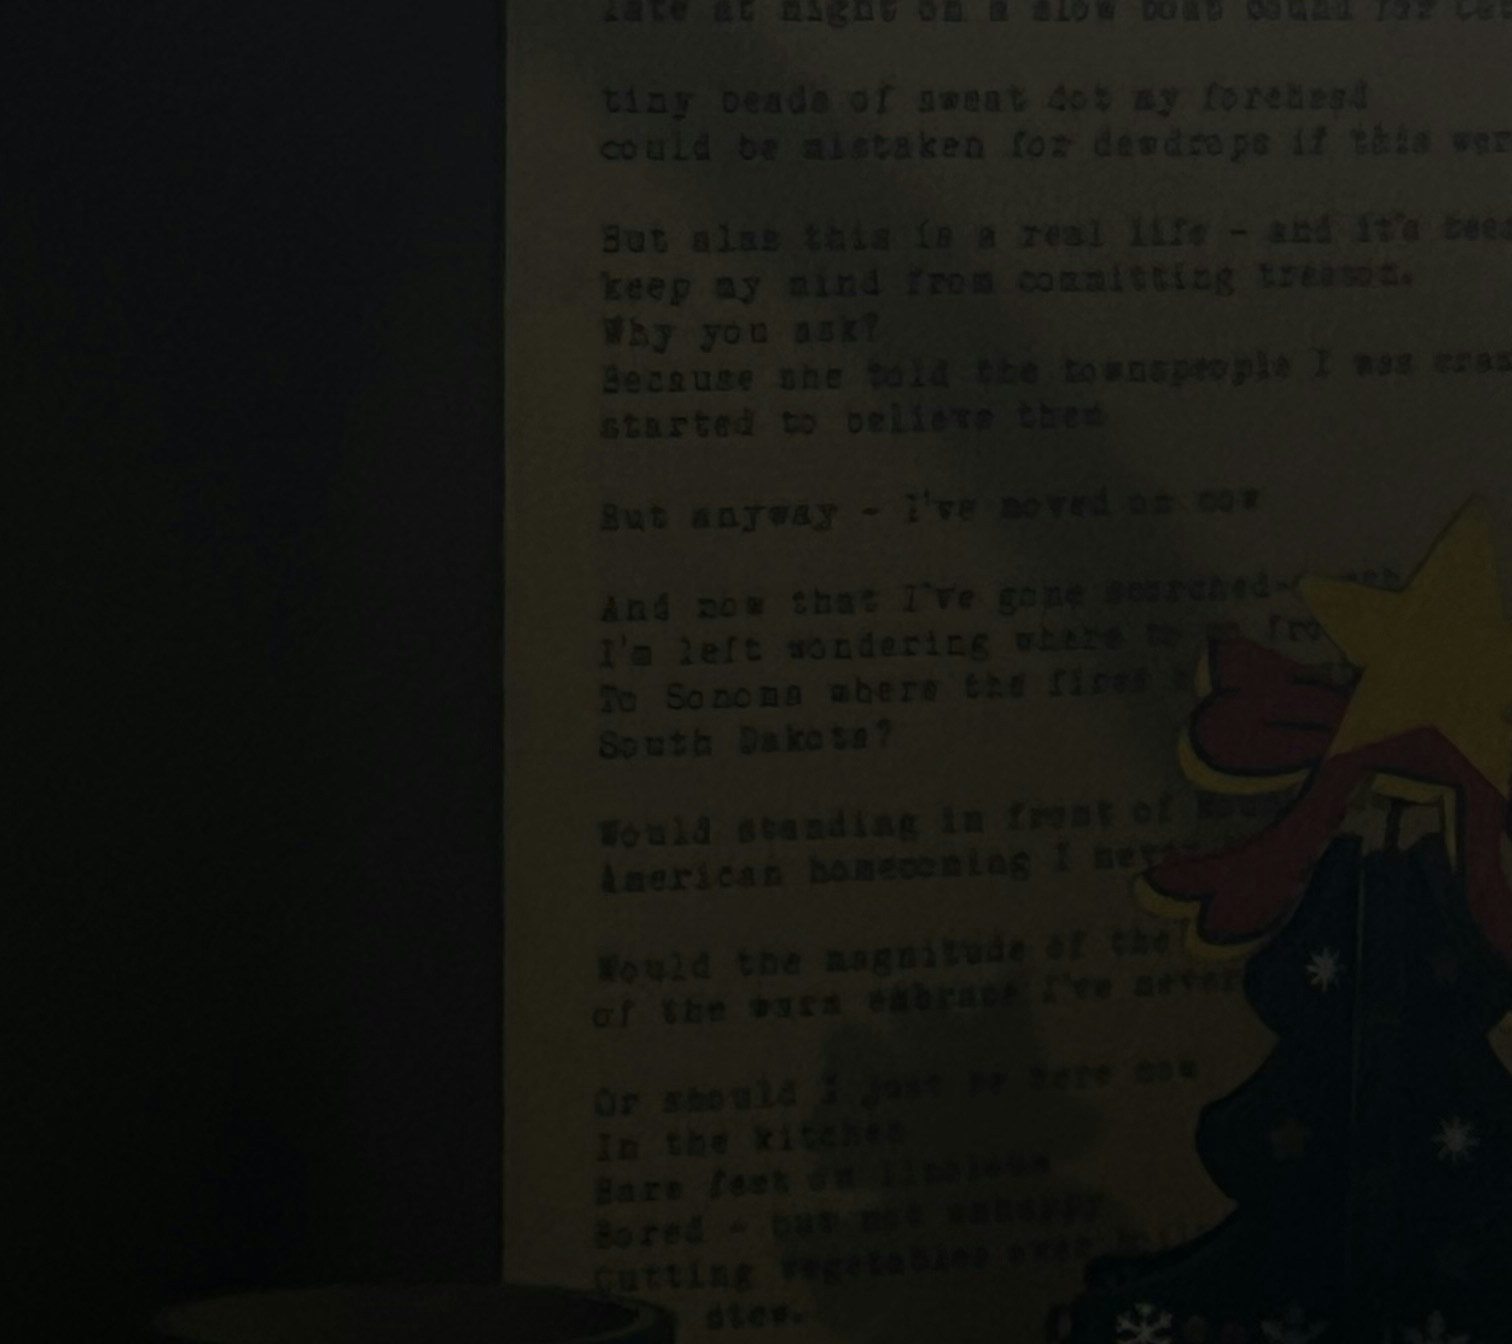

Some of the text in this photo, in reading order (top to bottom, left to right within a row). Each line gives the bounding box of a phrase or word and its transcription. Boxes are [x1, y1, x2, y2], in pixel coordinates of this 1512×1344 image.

[601, 86, 695, 121] tiny
[849, 84, 896, 115] of
[1047, 84, 1113, 112] dot
[1133, 87, 1180, 118] my
[600, 130, 712, 161] could
[738, 132, 779, 161] be
[801, 128, 986, 161] mistaken
[1011, 128, 1072, 159] for
[1092, 126, 1271, 162] dewdrops
[1291, 125, 1328, 157] if
[601, 224, 669, 254] But
[692, 223, 782, 253] alas
[804, 222, 890, 252] this
[917, 219, 954, 250] is
[977, 223, 997, 248] a
[1021, 220, 1105, 247] real
[1130, 216, 1208, 247] life
[1267, 214, 1333, 244] and
[601, 271, 691, 306] keep
[714, 272, 762, 304] my
[789, 268, 882, 298] mind
[906, 268, 995, 296] from
[1015, 264, 1237, 296] committing
[601, 311, 881, 353] Why you ask?
[601, 363, 755, 395] Because
[867, 357, 951, 389] told
[976, 356, 1040, 386] the
[1064, 349, 1292, 386] townspeople
[1312, 347, 1333, 378] I
[1352, 351, 1416, 376] was
[599, 401, 1108, 440] started to believe them
[600, 502, 668, 532] But
[691, 503, 838, 533] anyway
[906, 487, 977, 523] I've
[1001, 485, 1112, 519] moved
[600, 592, 670, 622] And
[696, 597, 765, 620] now
[792, 587, 879, 615] that
[905, 583, 975, 615] I've
[998, 585, 1086, 617] gone
[598, 634, 652, 668] I'm
[679, 636, 763, 667] left
[788, 630, 990, 661] wondering
[600, 684, 637, 713] To
[666, 682, 803, 711] Sonoma
[830, 676, 939, 704] where
[965, 671, 1026, 699] the
[599, 718, 892, 760] South Dakota?
[598, 814, 711, 848] Would
[737, 808, 921, 843] standing
[941, 805, 984, 835] in
[1008, 800, 1113, 832] front
[600, 860, 783, 894] American
[809, 850, 1031, 882] homecoming
[1052, 840, 1070, 873] I
[597, 953, 713, 983] Would
[737, 950, 802, 977] the
[824, 933, 1026, 978] magnitude
[1045, 928, 1087, 960] of
[592, 997, 634, 1028] of
[662, 995, 727, 1025] the
[595, 1086, 639, 1118] Or
[663, 1074, 797, 1114] should
[596, 1119, 906, 1162] In the kitchen
[595, 1176, 682, 1205] Bare
[708, 1167, 790, 1199] feet
[595, 1215, 705, 1250] Bored
[595, 1259, 755, 1293] Cutting
